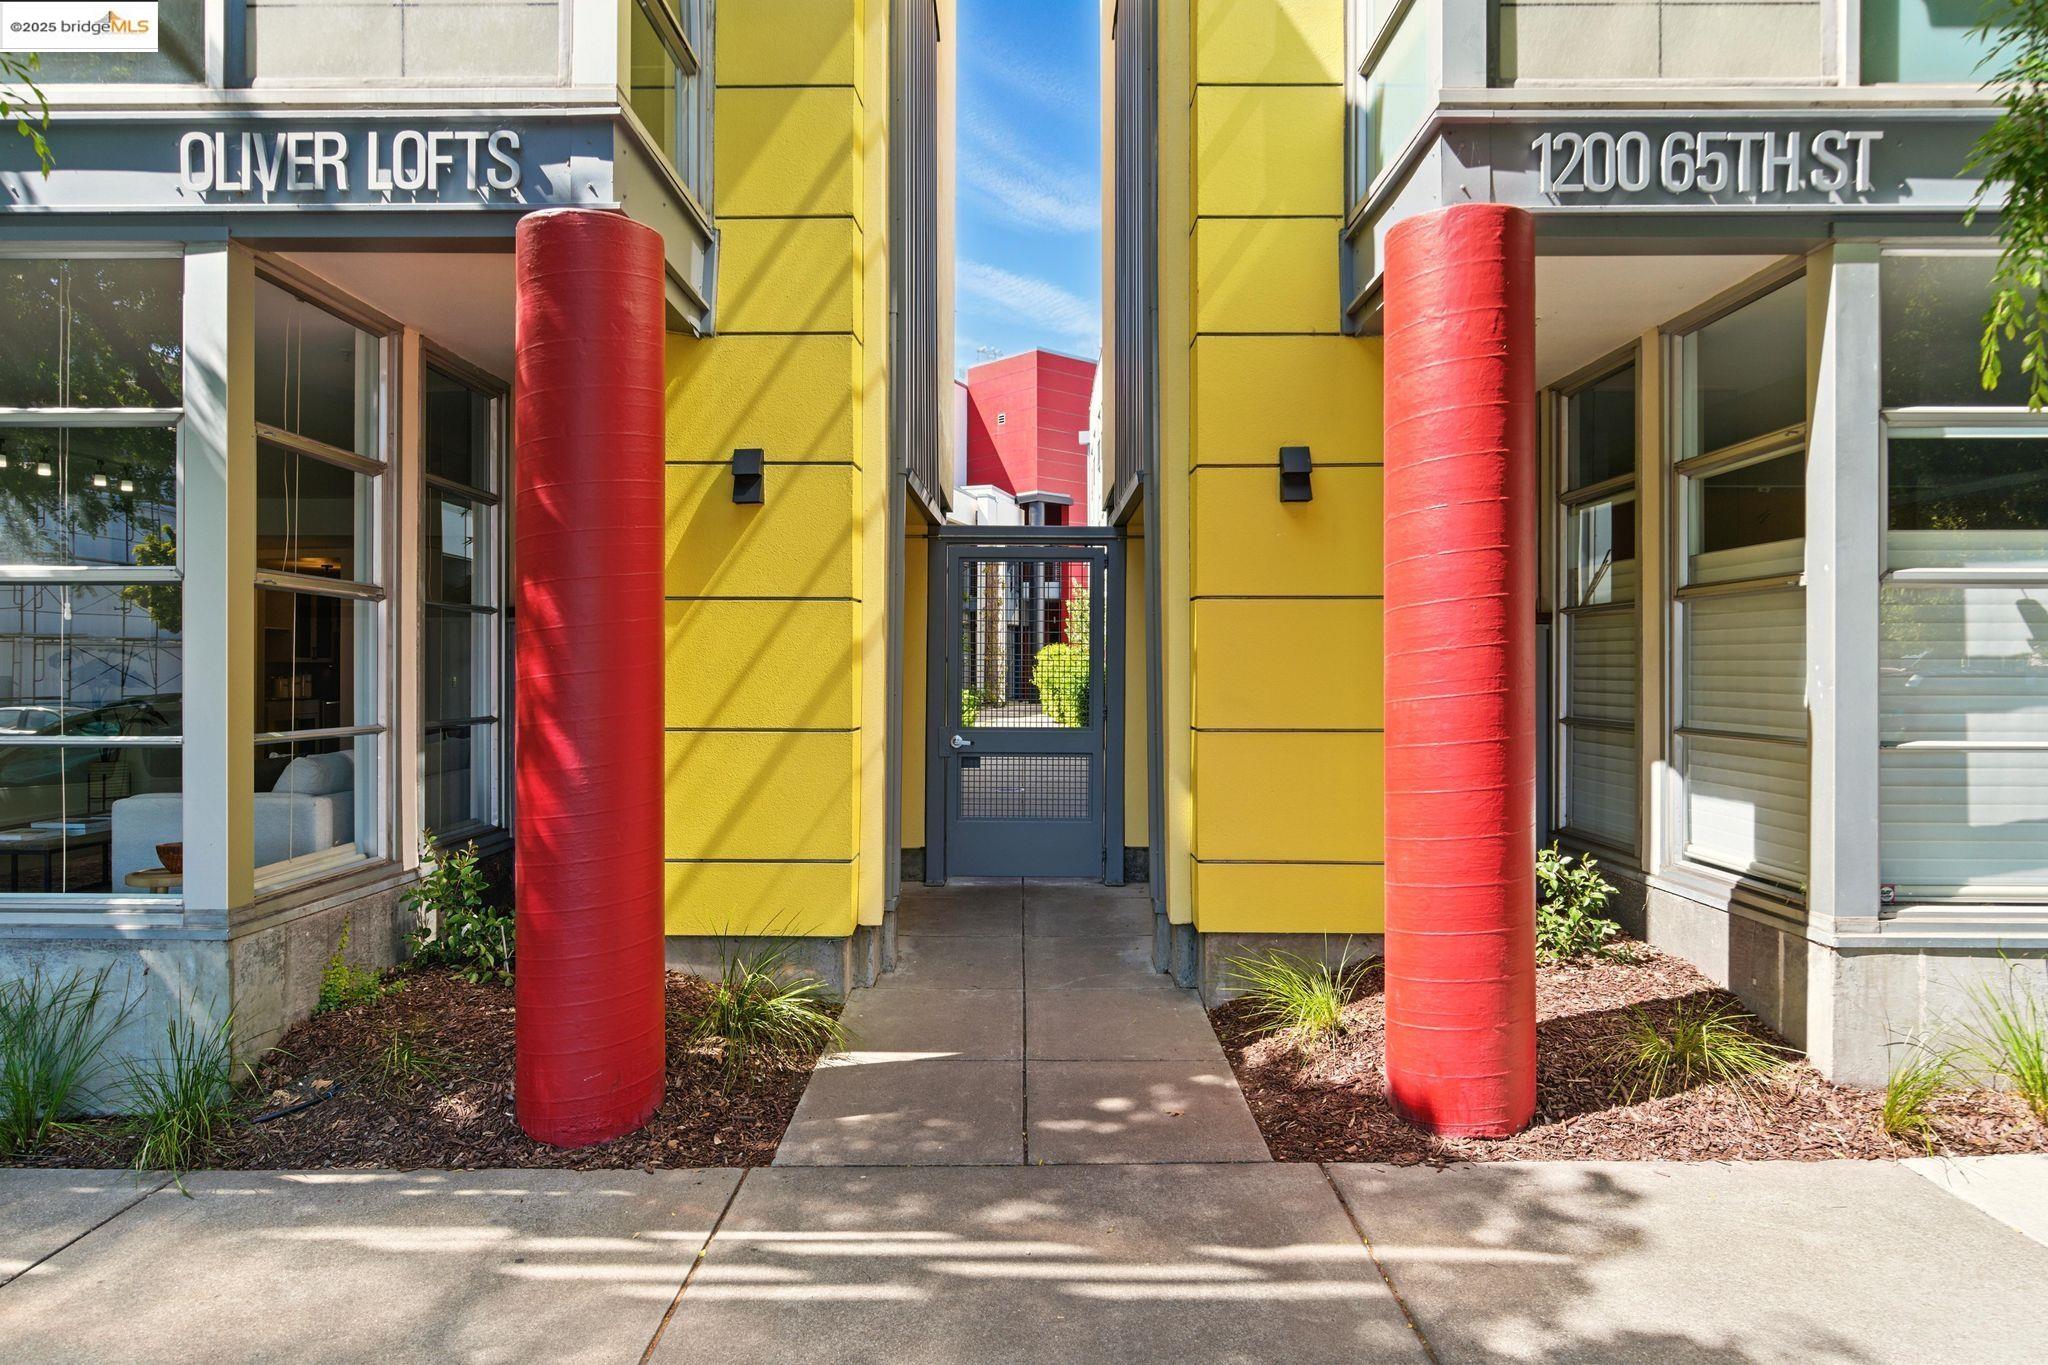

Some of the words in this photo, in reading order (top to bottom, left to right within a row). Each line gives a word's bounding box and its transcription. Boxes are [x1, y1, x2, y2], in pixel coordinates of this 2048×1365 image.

[180, 131, 349, 192] OLIVER
[367, 130, 521, 191] LOFTS
[1531, 131, 1651, 194] 1200
[1660, 131, 1800, 194] 65TH
[1811, 130, 1884, 193] ST
